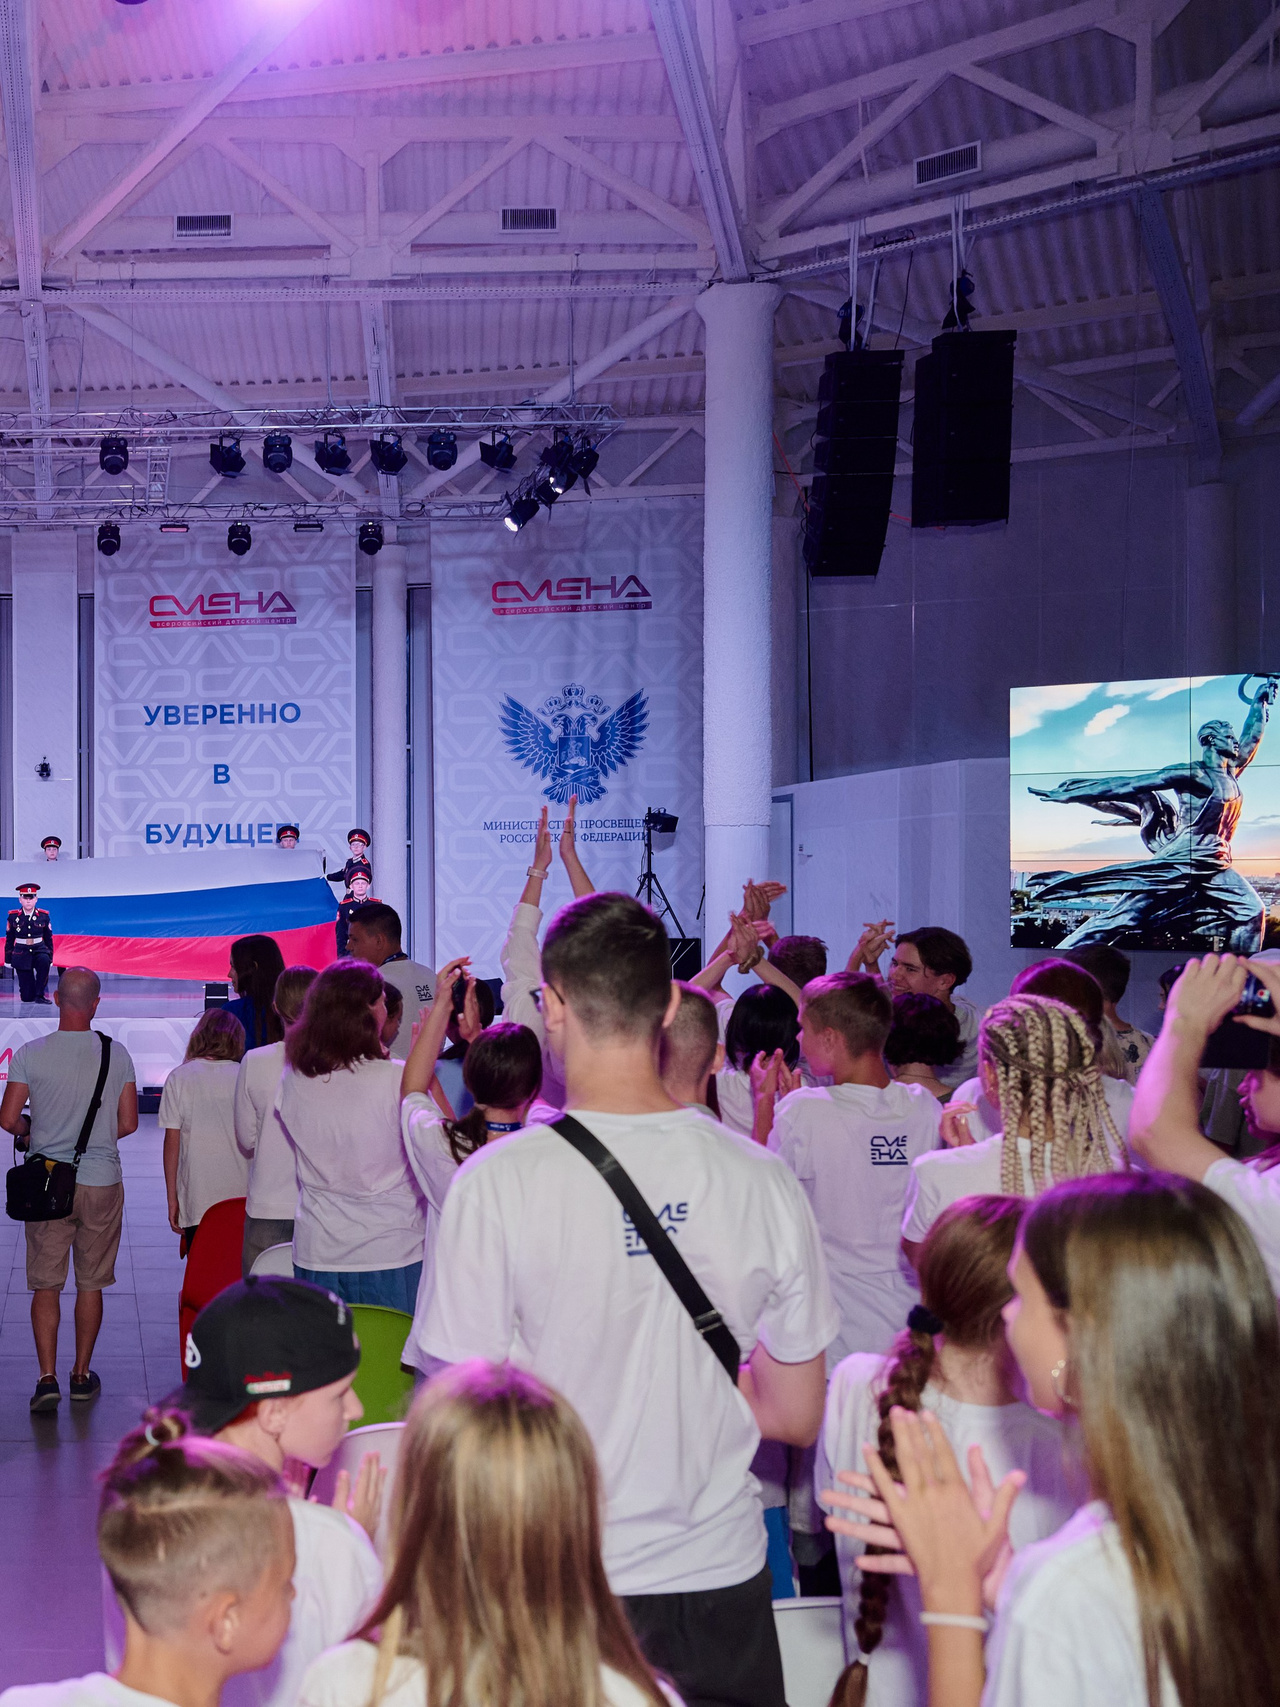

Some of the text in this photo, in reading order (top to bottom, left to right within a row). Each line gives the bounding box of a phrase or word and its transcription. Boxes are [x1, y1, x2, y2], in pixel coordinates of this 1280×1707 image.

[499, 602, 646, 615] всероссийский детский центр
[156, 617, 291, 628] всероссийский детский центр
[143, 702, 302, 727] УВЕРЕННО
[213, 763, 231, 785] В
[483, 818, 647, 831] МИНИСТЕСТ ПРОСВЕЩЕ
[145, 822, 300, 848] БУДУЩЕ
[500, 833, 577, 844] РОССИСК
